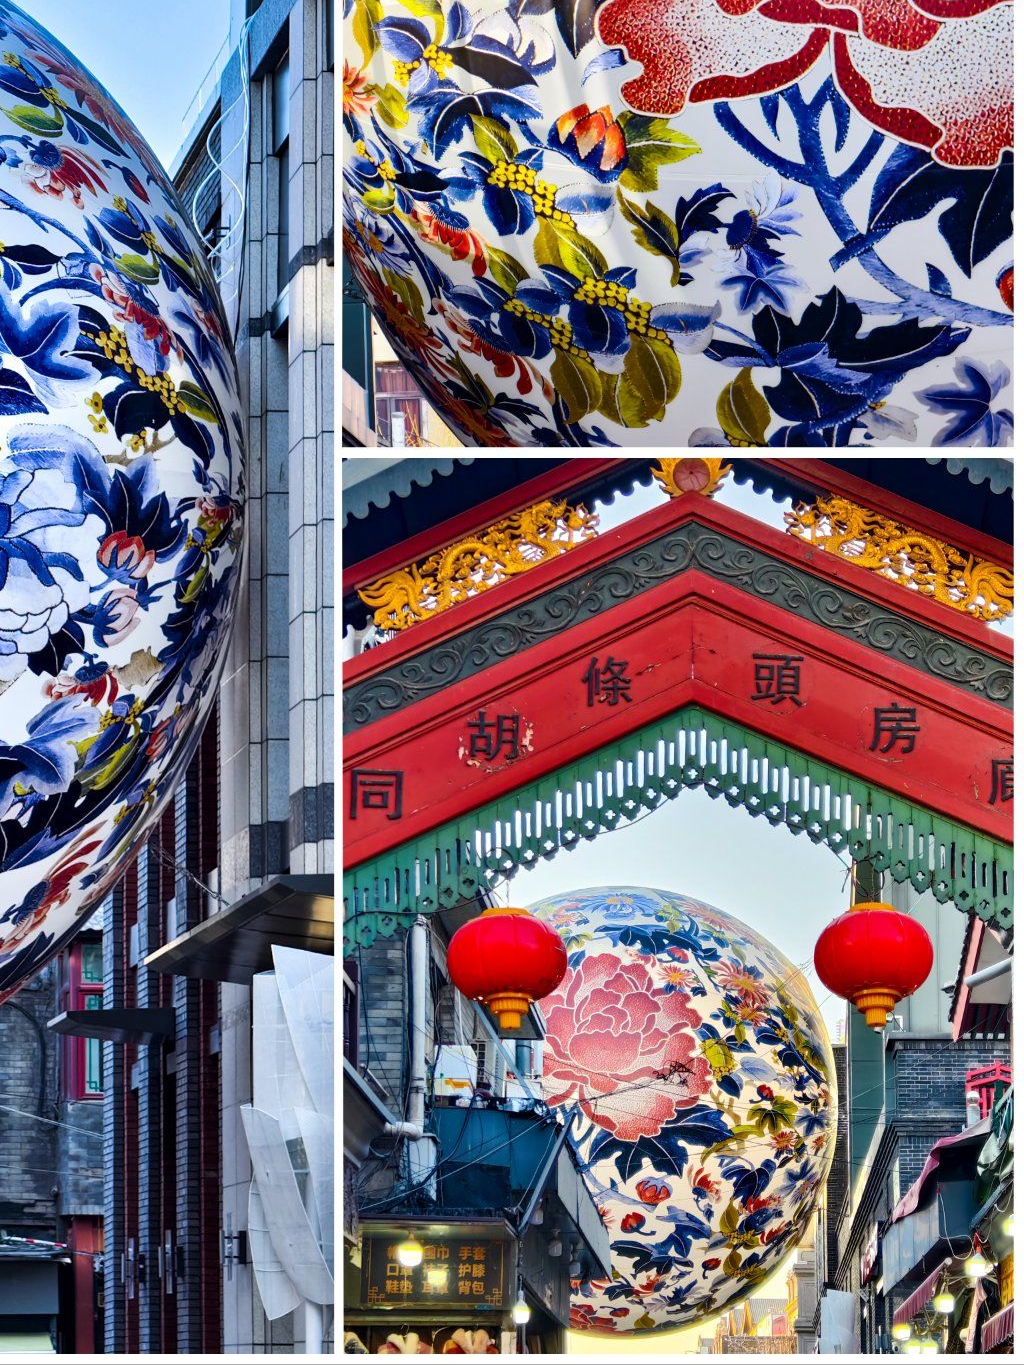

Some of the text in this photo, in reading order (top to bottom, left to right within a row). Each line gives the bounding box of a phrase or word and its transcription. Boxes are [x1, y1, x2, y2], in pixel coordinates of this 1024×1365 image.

[459, 1246, 486, 1260] 手套
[458, 1263, 486, 1278] 护膝
[386, 1280, 413, 1295] 鞋垫
[458, 1280, 485, 1295] 背包
